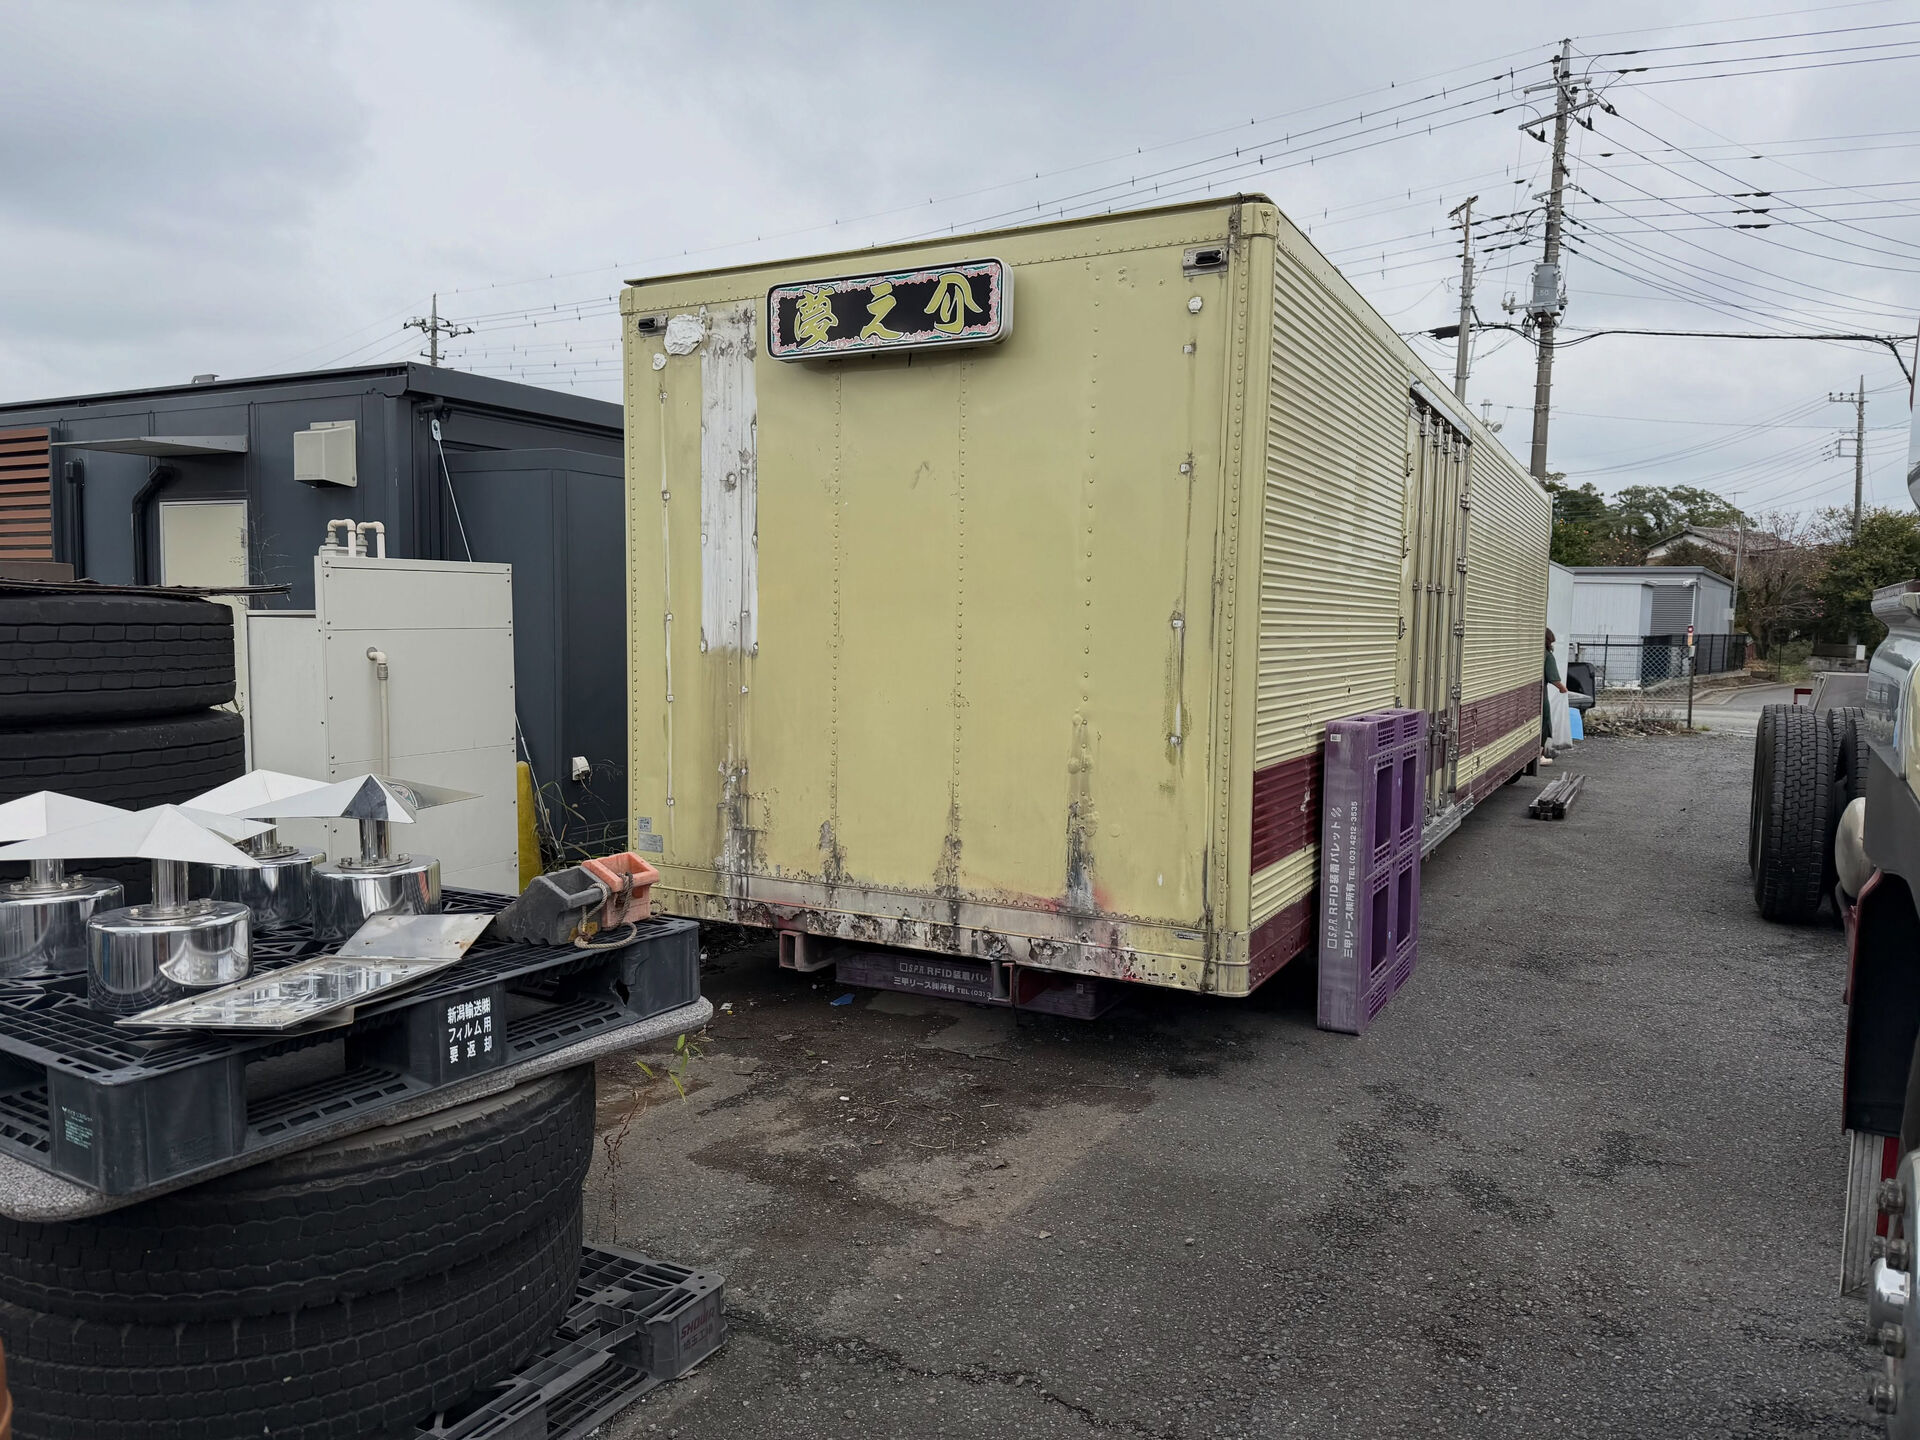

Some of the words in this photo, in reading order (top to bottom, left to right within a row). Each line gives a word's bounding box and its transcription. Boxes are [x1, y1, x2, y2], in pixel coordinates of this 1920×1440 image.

[1348, 865, 1356, 881] TEL
[956, 987, 970, 995] TEL
[448, 1016, 492, 1043] フィルム用
[449, 1035, 493, 1064] 要返却
